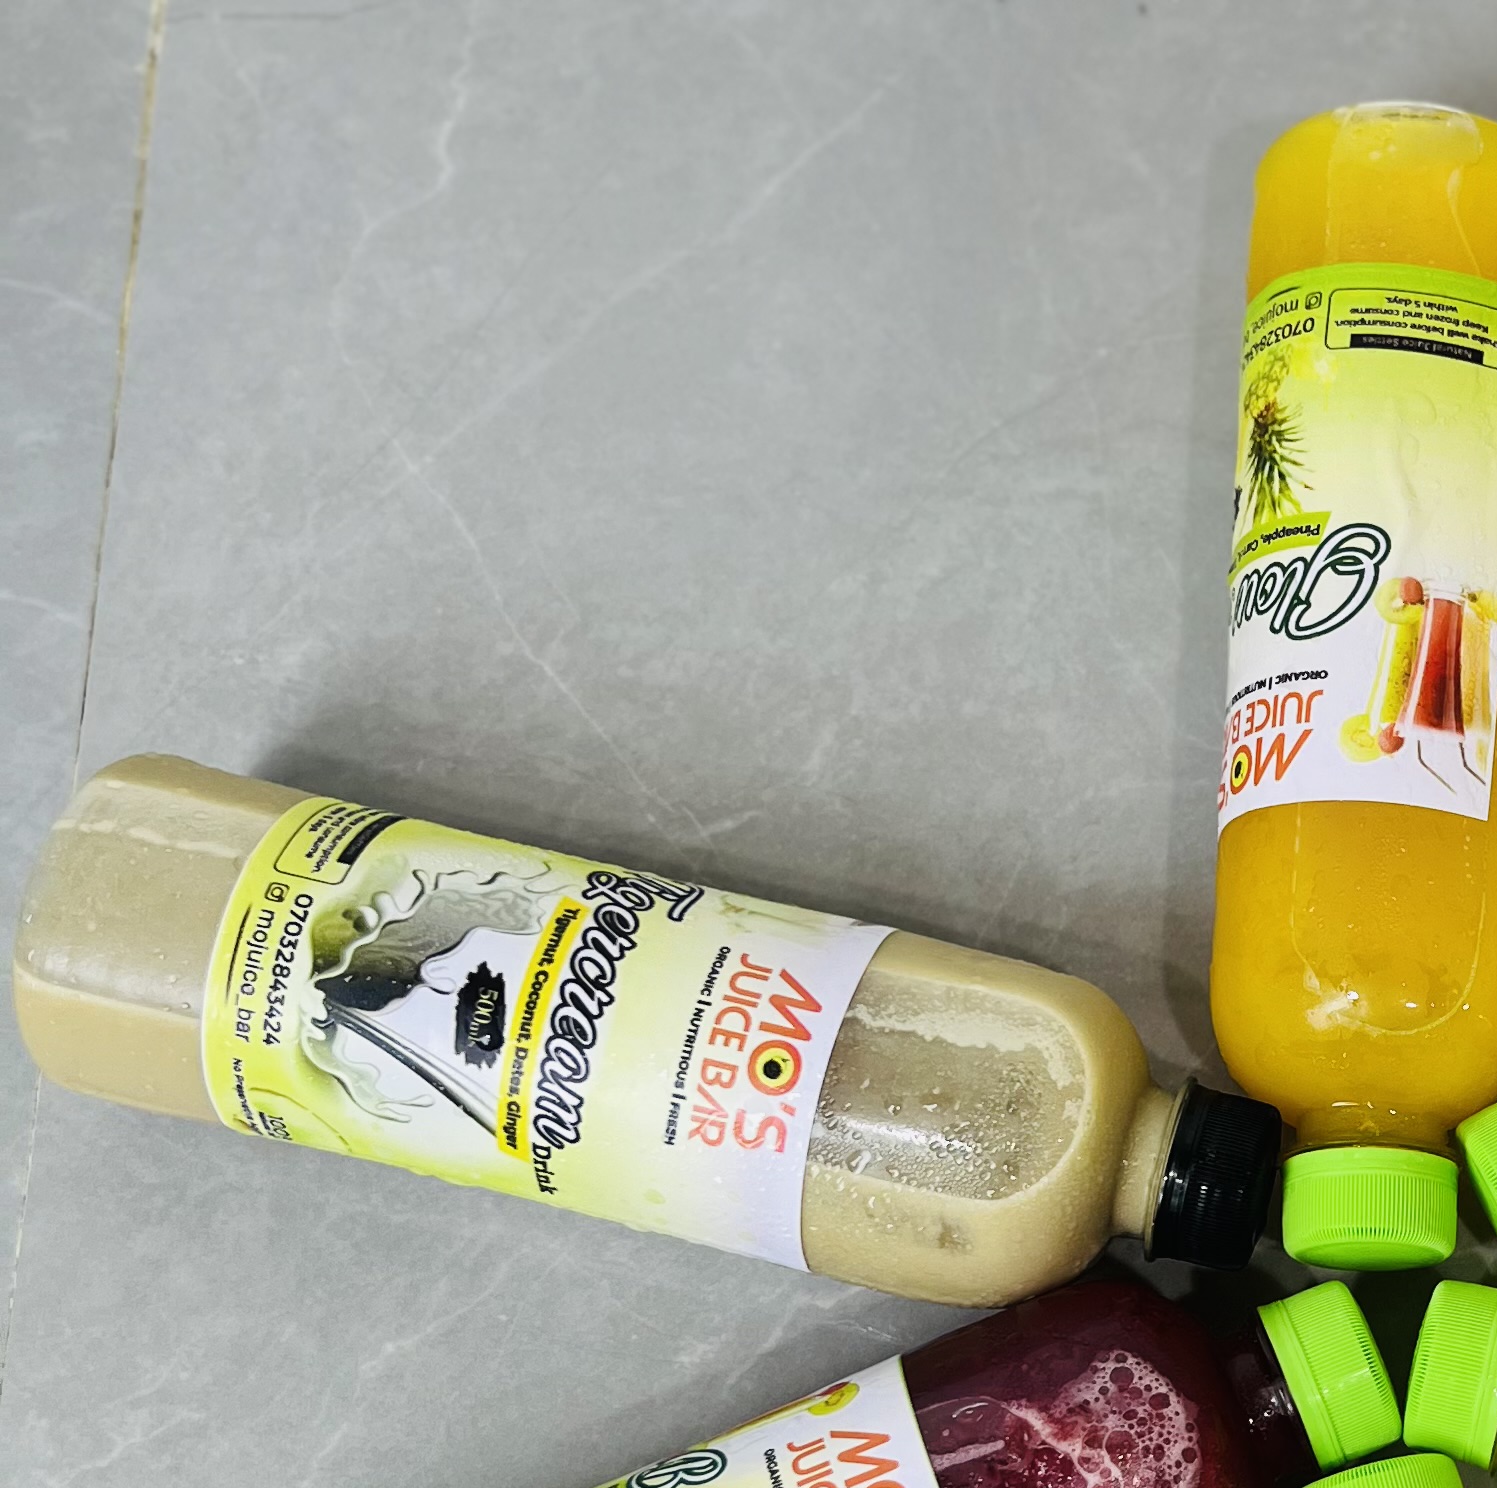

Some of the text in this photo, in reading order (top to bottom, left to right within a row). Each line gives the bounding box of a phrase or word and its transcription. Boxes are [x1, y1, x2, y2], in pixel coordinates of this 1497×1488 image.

[1401, 310, 1422, 320] and
[1413, 300, 1420, 308] 5
[1422, 300, 1457, 313] within
[1425, 312, 1459, 327] frozen
[1410, 322, 1444, 335] before
[1446, 328, 1469, 340] well
[1260, 523, 1320, 545] Pineapple,
[1274, 669, 1328, 684] ORGANIC
[1244, 689, 1323, 736] JUICE
[233, 909, 275, 1043] mojuice_bar
[261, 893, 313, 1045] 07032843424
[515, 969, 549, 1042] Coconut,
[530, 870, 704, 1193] Tigercream Drink
[663, 946, 731, 1145] ORGANIC NUTRITIOUS FRESH
[232, 1057, 241, 1072] No
[687, 953, 773, 1147] JUICE BAR
[732, 968, 822, 1153] MO'S
[500, 1100, 520, 1149] Ginger
